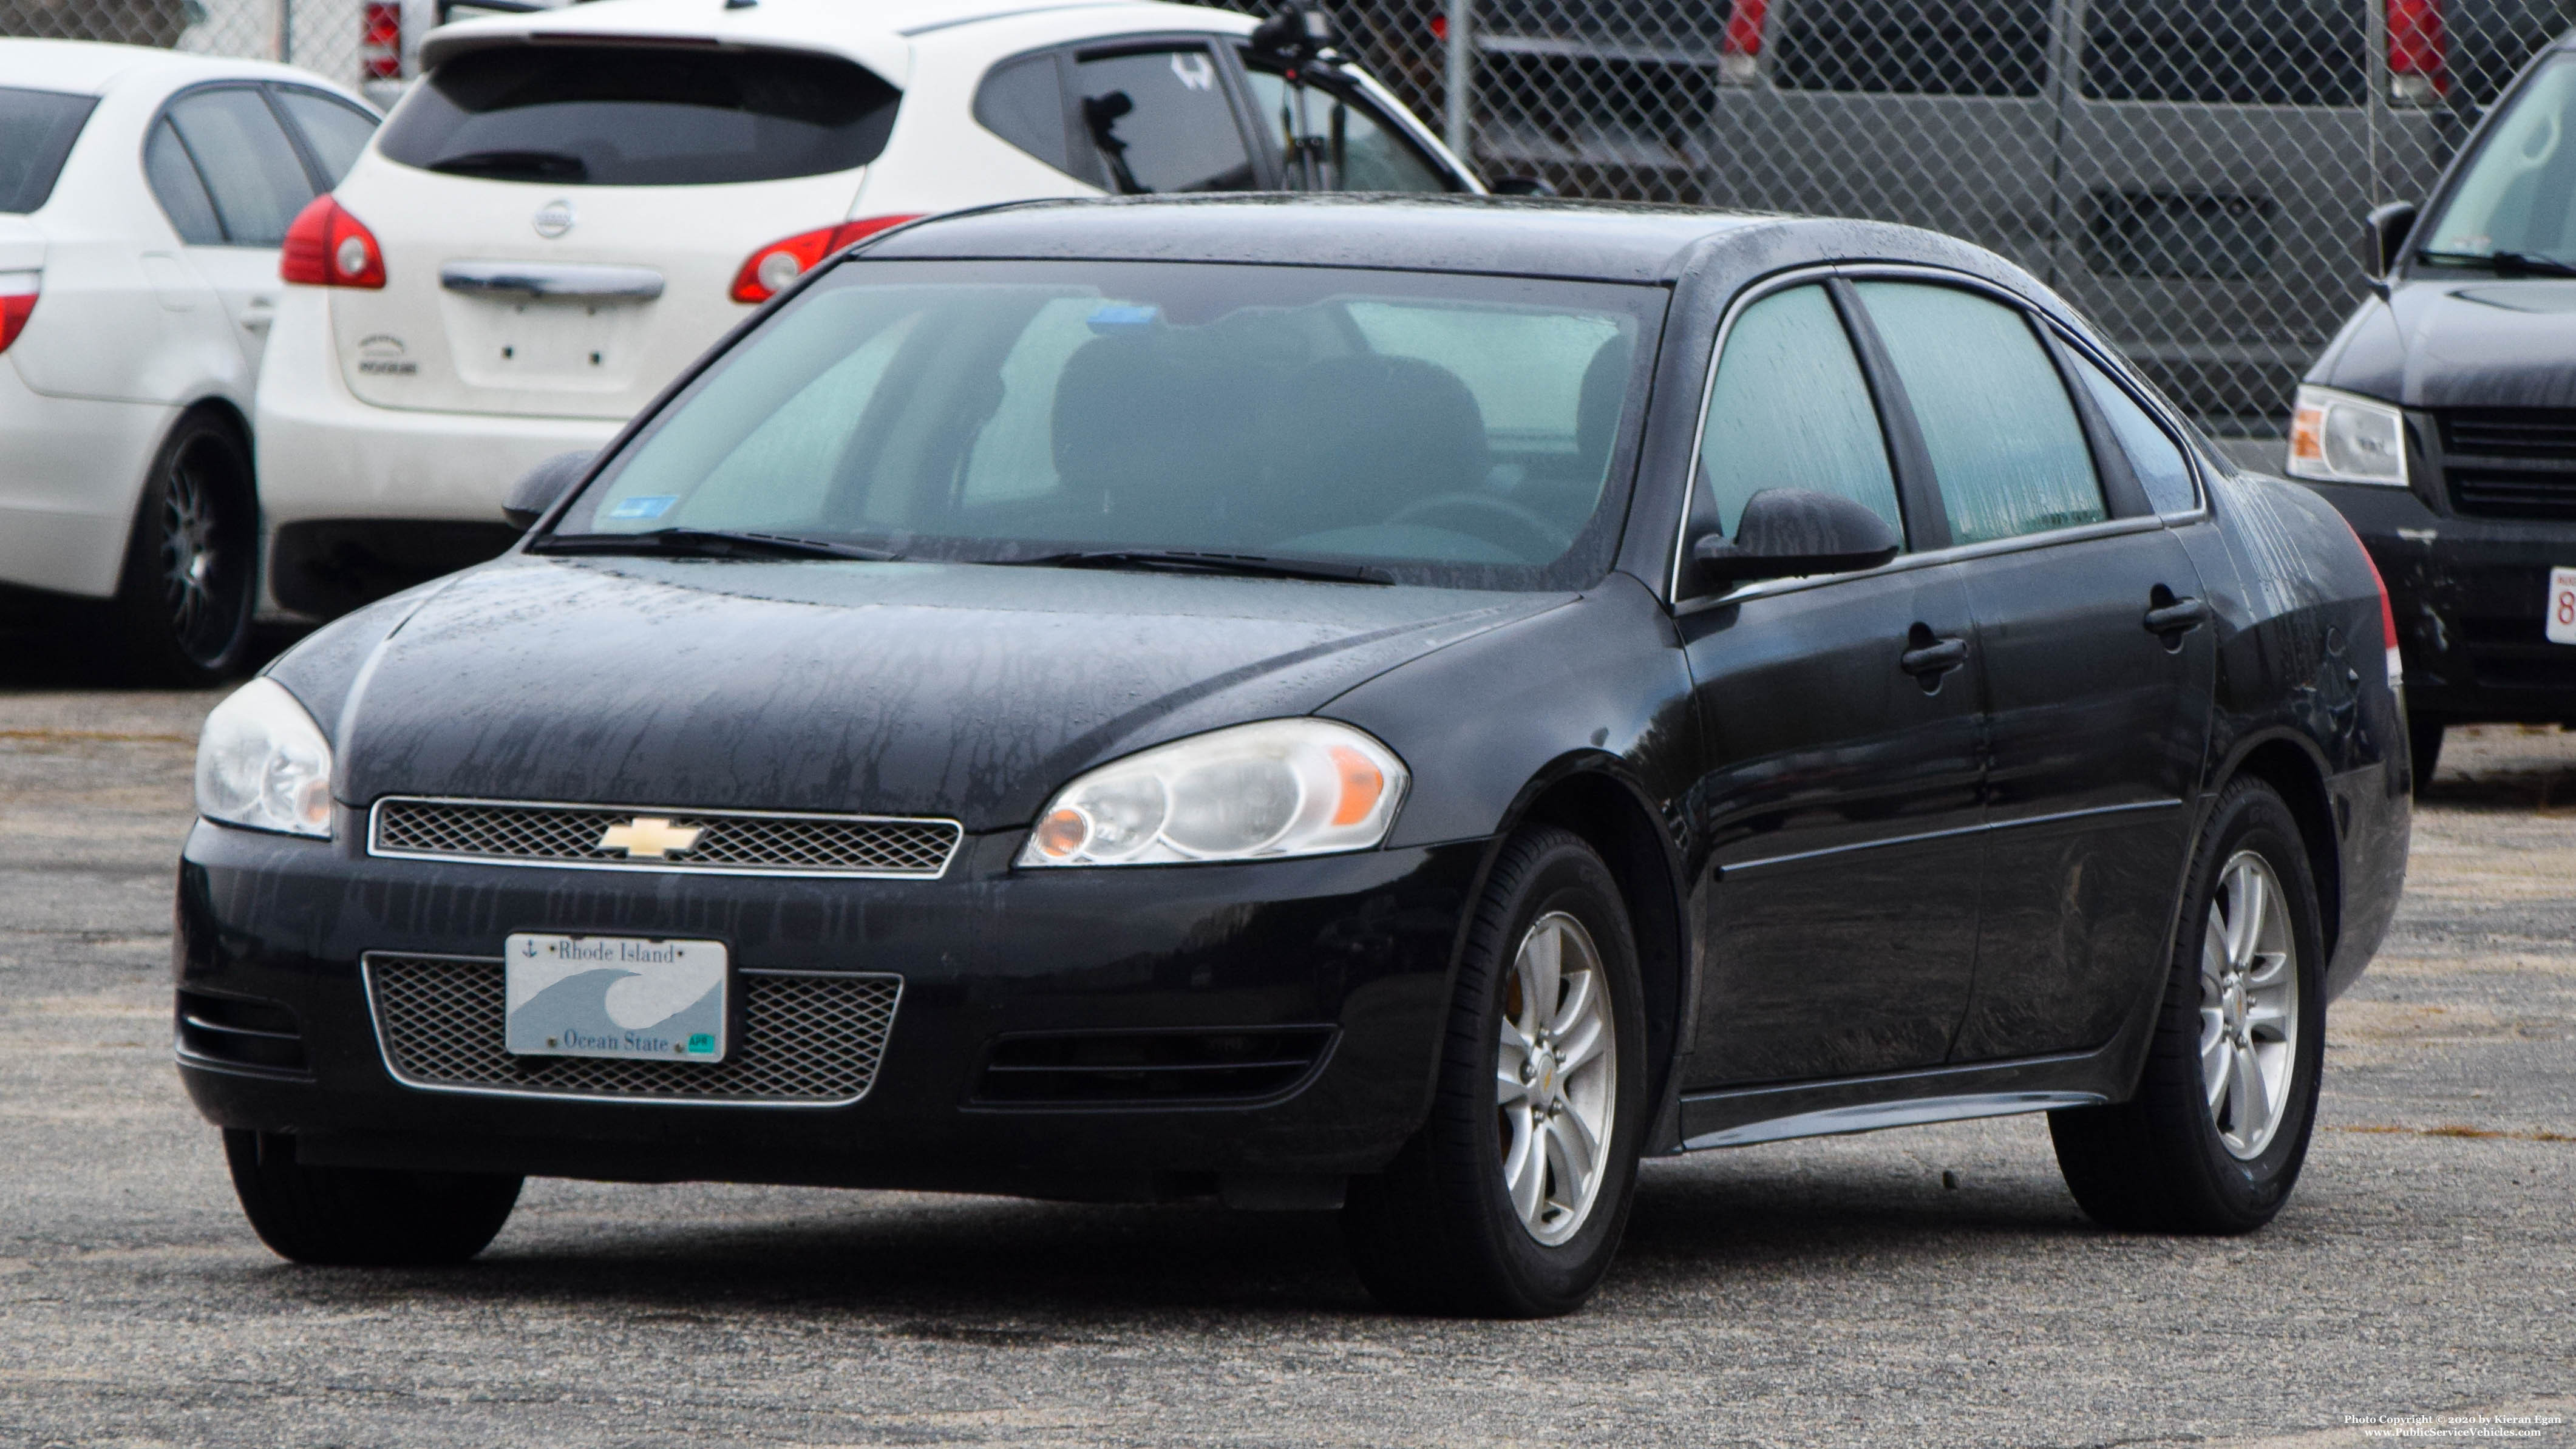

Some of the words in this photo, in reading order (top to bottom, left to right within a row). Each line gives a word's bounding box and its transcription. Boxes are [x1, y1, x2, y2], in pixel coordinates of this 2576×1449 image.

[559, 940, 613, 960] Rhode
[620, 942, 675, 963] Island
[564, 1028, 618, 1049] Ocean
[624, 1030, 668, 1051] State
[690, 1037, 707, 1045] APR
